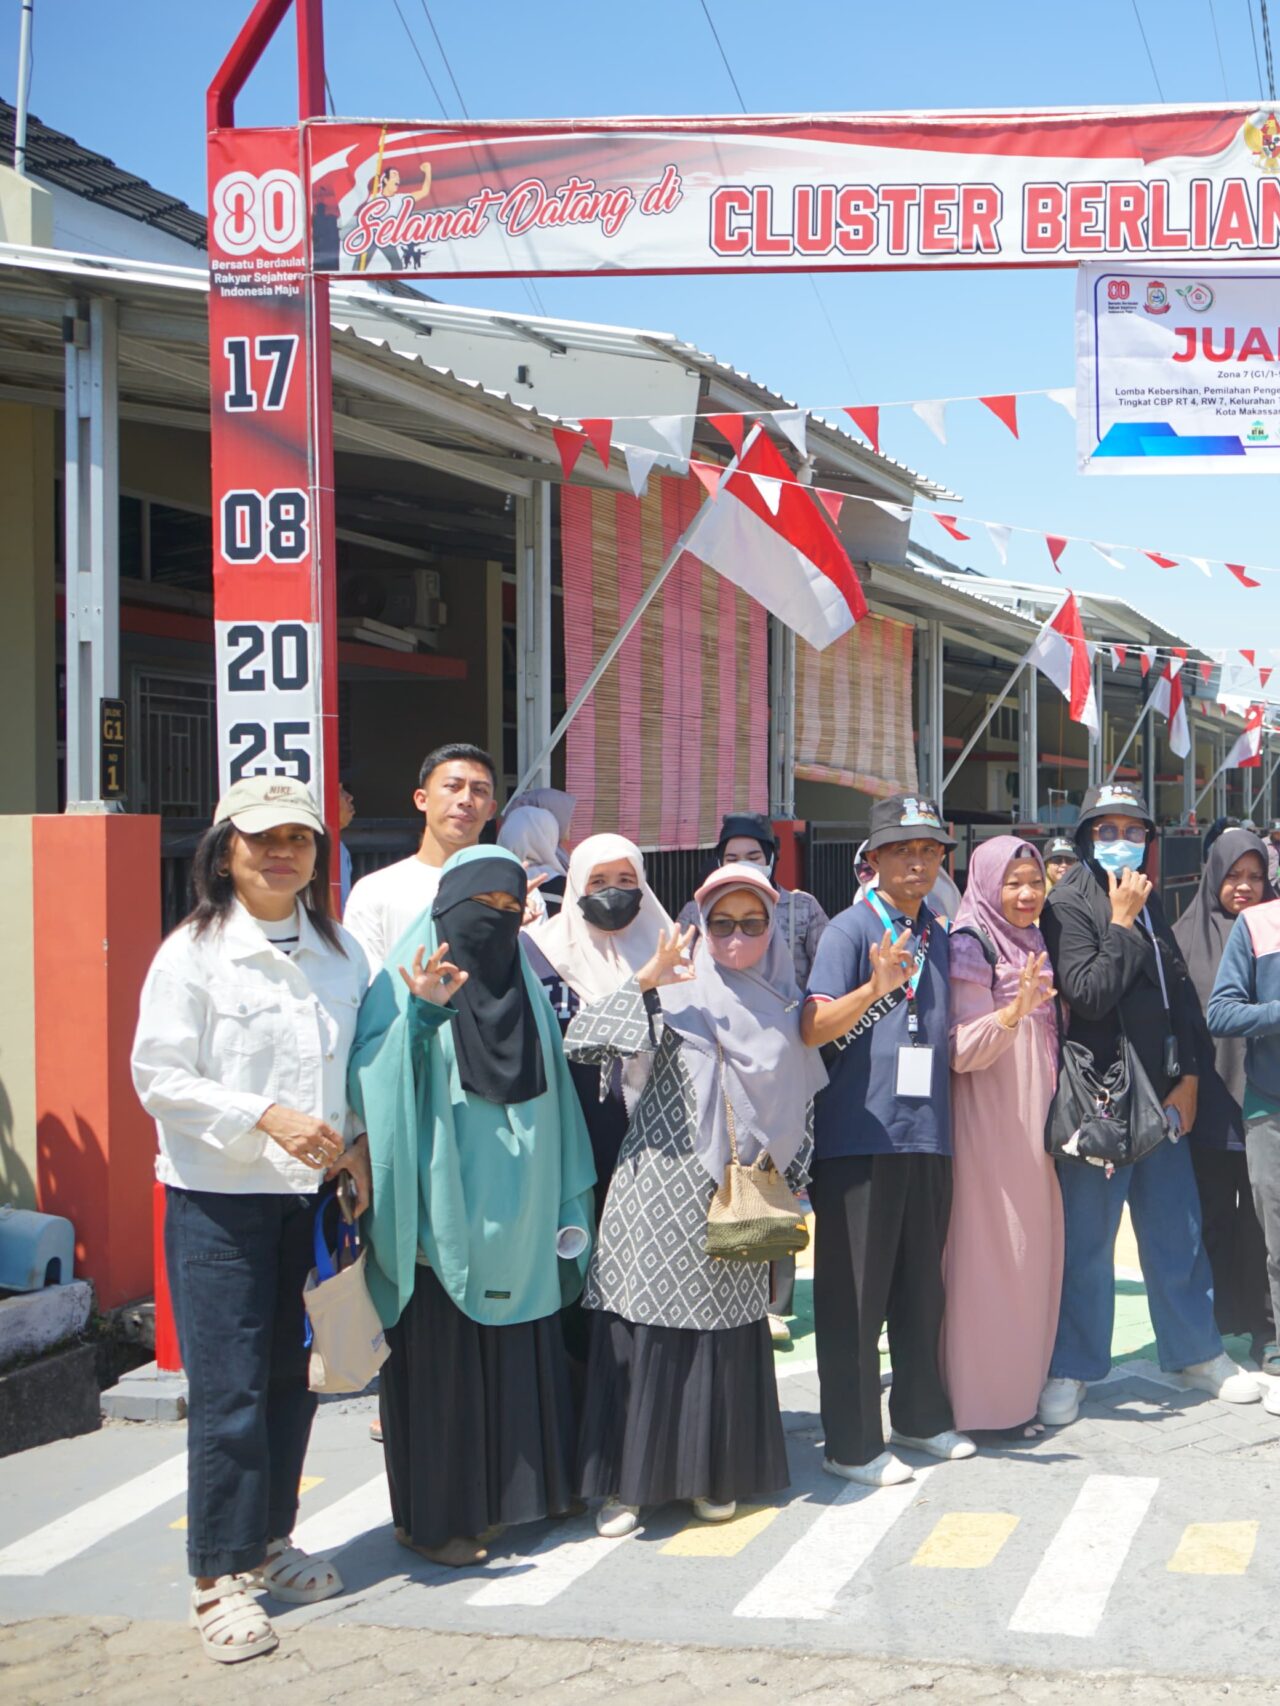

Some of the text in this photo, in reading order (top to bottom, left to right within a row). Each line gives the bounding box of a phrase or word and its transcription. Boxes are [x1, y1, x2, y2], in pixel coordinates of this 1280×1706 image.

[213, 168, 305, 256] 80
[344, 164, 683, 255] Selamat Datang di
[709, 182, 1003, 257] CLUSTER
[211, 257, 306, 270] Bersatu Berdaulat
[221, 284, 300, 297] Indonesia Maju
[224, 335, 299, 412] 17
[1115, 388, 1146, 396] Lomba
[1204, 386, 1251, 395] Pemilahan
[1217, 370, 1241, 378] Zona
[1243, 370, 1249, 378] 7
[1119, 398, 1151, 407] Tingkat
[1201, 397, 1217, 405] RW
[1229, 396, 1275, 405] Kelurahan
[1216, 408, 1236, 416] Kota
[1239, 407, 1280, 416] Makassar
[220, 489, 309, 564] 08
[227, 623, 309, 692] 20
[103, 721, 124, 740] G1
[229, 721, 311, 786] 25
[107, 766, 119, 790] 1
[833, 993, 897, 1051] LACOSTE
